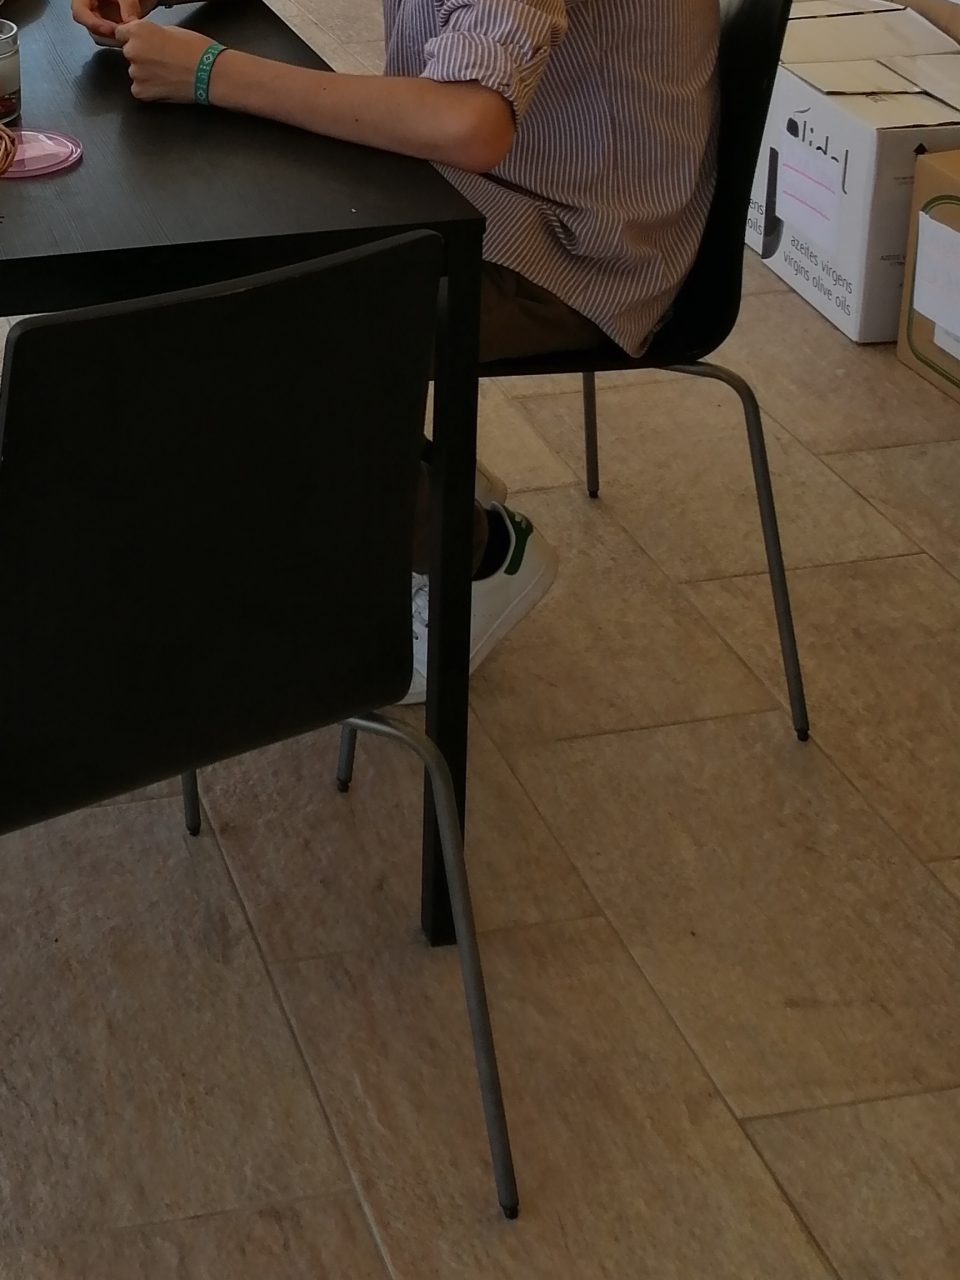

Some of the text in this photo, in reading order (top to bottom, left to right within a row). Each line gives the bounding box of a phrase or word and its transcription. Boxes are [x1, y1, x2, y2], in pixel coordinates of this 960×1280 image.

[783, 250, 851, 317] virgins olive oils
[790, 235, 853, 295] azeites virgens
